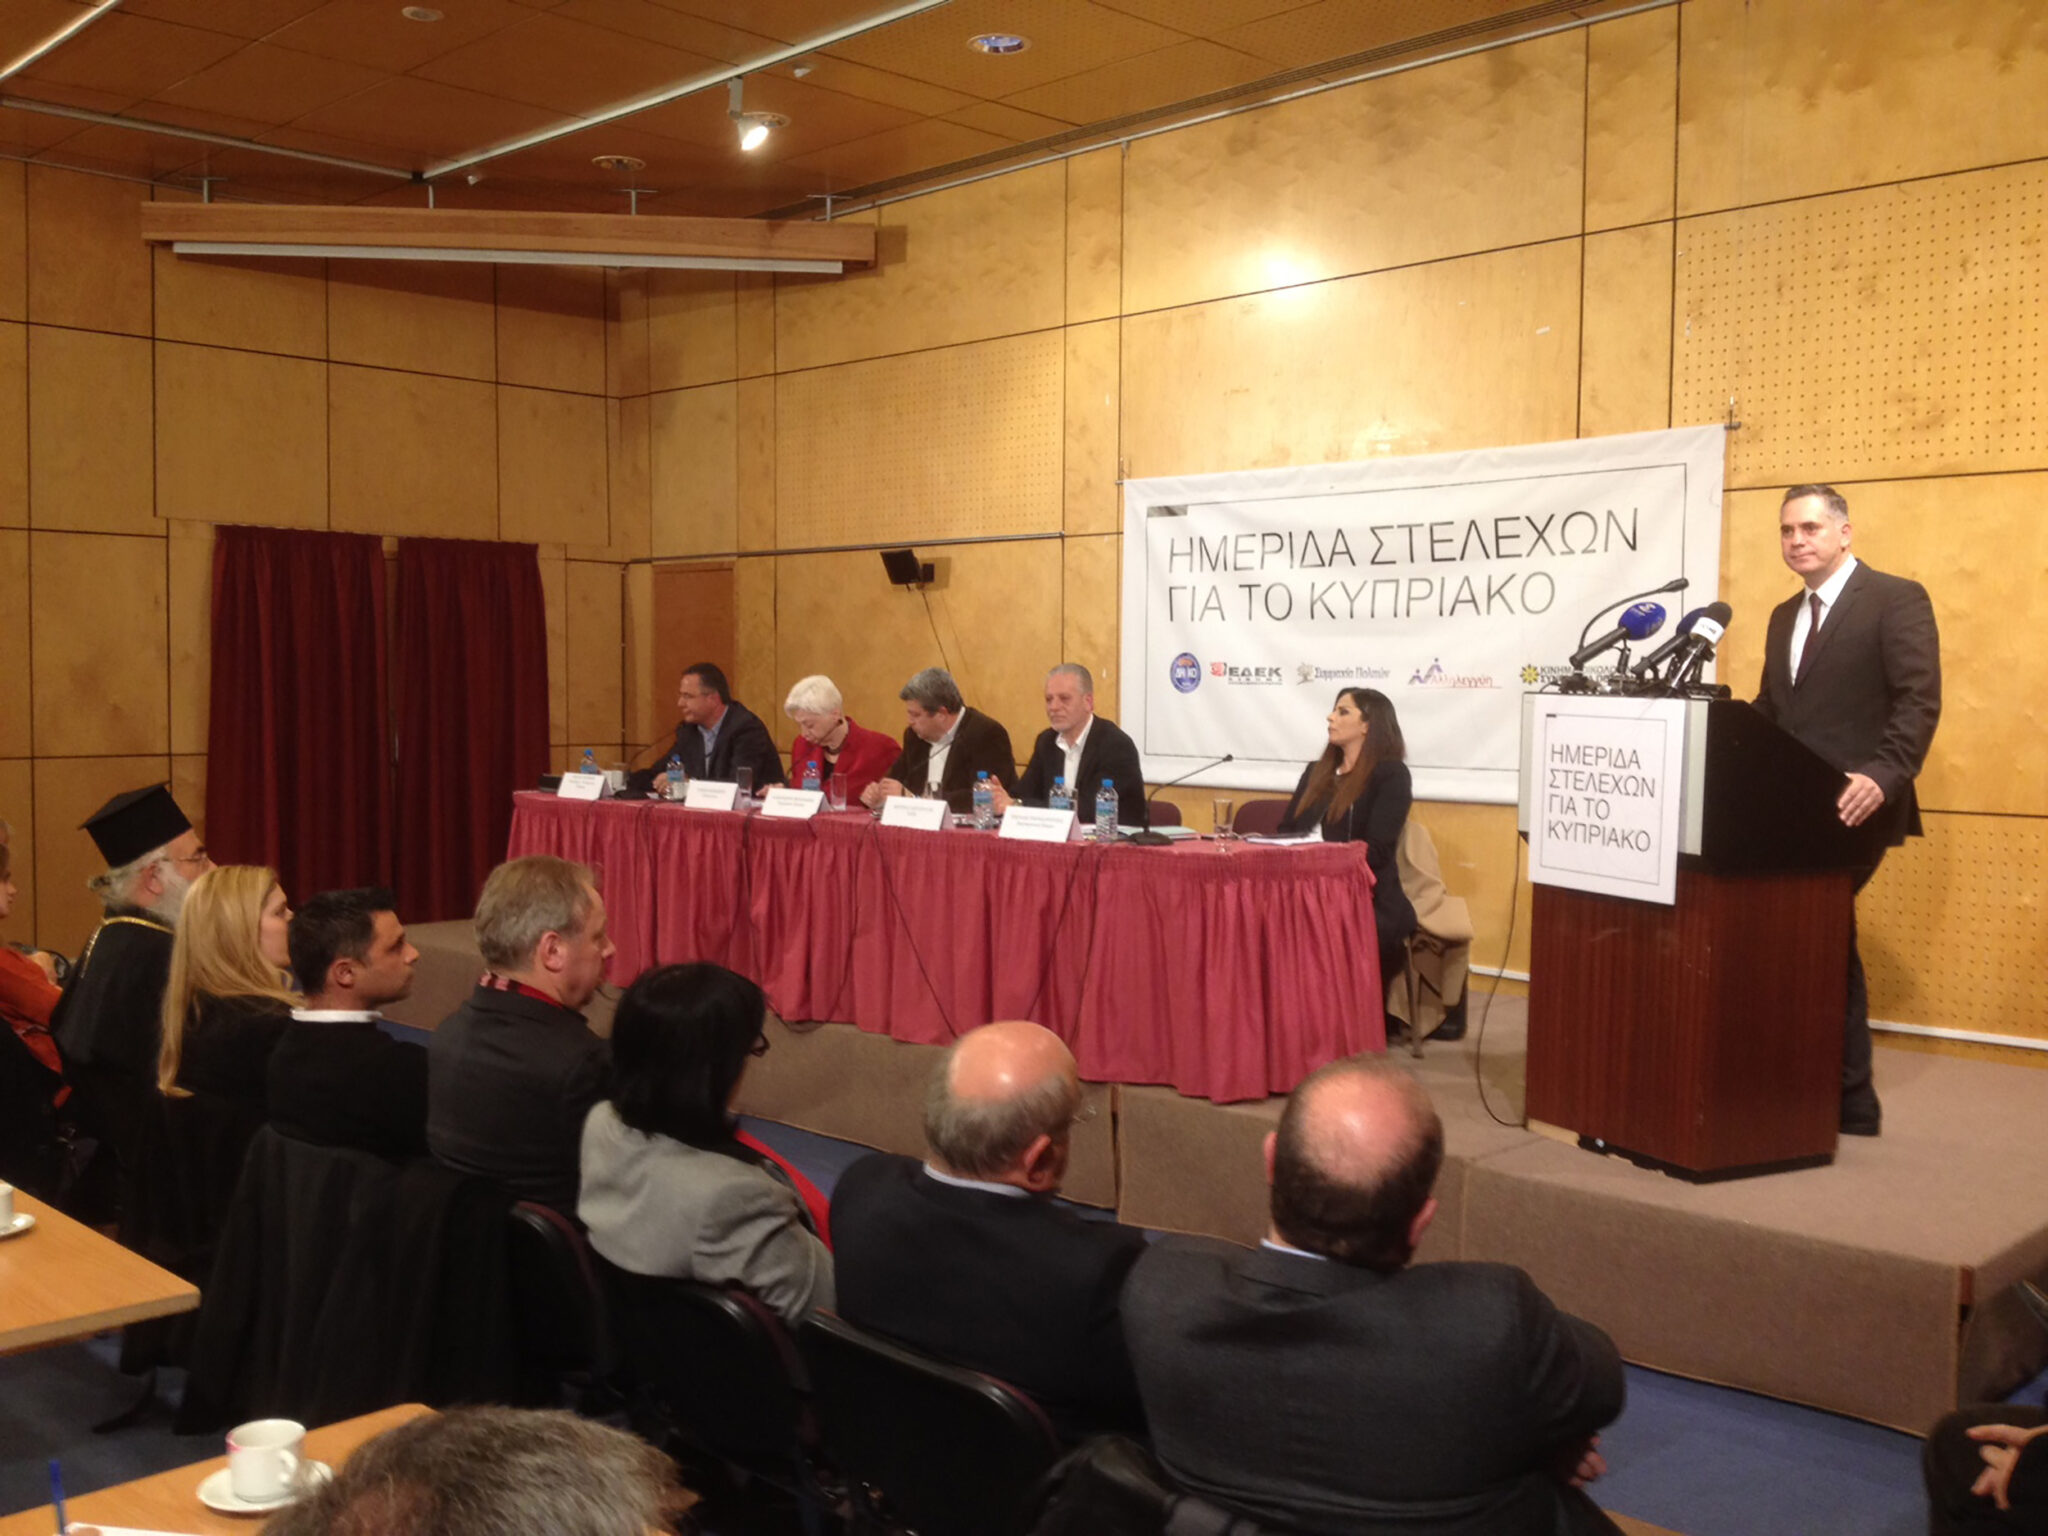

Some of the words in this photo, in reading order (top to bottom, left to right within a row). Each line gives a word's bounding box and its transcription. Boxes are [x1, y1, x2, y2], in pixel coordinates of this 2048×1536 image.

[1168, 527, 1357, 574] ΗΜΕΡΙΔΑ
[1369, 506, 1639, 566] ΣΤΕΛΕΧΩΝ
[1168, 584, 1226, 622] ΓΙΑ
[1238, 582, 1293, 622] ΤΟ
[1309, 571, 1556, 620] ΚΥΠΡΙΑΚΟ
[1227, 666, 1283, 678] ΕΔΕΚ
[1540, 665, 1573, 675] ΚΙΝΗΜ
[1550, 743, 1642, 771] ΗΜΕΡΙΔΑ
[1548, 768, 1656, 799] ΣΤΕΛΕΧΩΝ
[1548, 794, 1578, 817] ΓΙΑ
[1583, 796, 1611, 821] ΤΟ
[1547, 819, 1652, 853] ΚΥΠΡΙΑΚΟ
